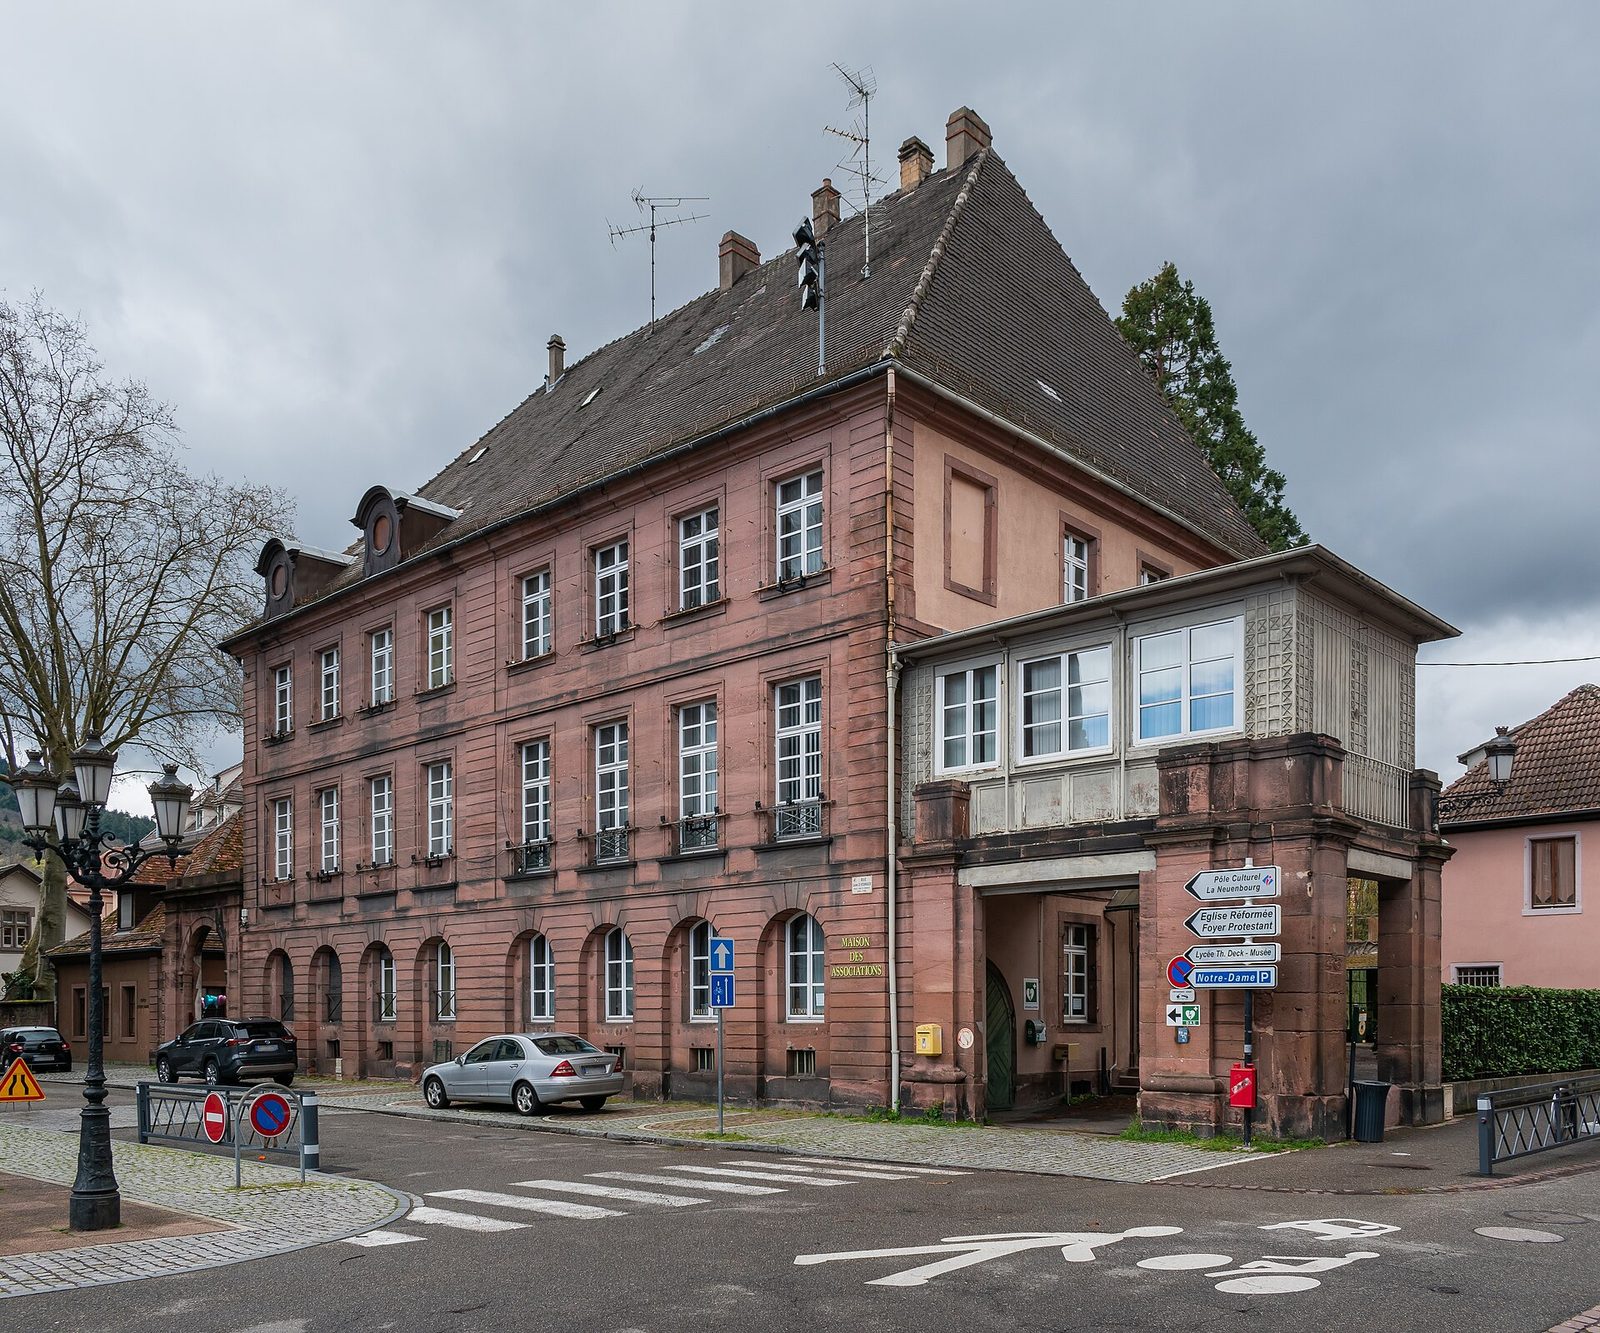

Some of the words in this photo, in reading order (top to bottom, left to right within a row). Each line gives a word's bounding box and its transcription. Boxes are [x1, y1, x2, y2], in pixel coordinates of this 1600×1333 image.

[1214, 874, 1230, 884] Pôle
[1232, 873, 1261, 882] Culturel
[1206, 886, 1215, 894] La
[1216, 884, 1261, 894] Neuenbourg
[1200, 911, 1228, 923] Eglise
[1229, 909, 1274, 921] Réformée
[1201, 923, 1227, 934] Foyer
[1227, 921, 1273, 931] Protestant
[841, 936, 871, 948] MAISON
[849, 951, 864, 962] DES
[1195, 950, 1215, 960] Lycée
[1249, 949, 1272, 957] Musée
[831, 965, 883, 978] ASSOCIATIONS
[1196, 973, 1256, 982] Notre-Dame
[1261, 972, 1269, 981] P
